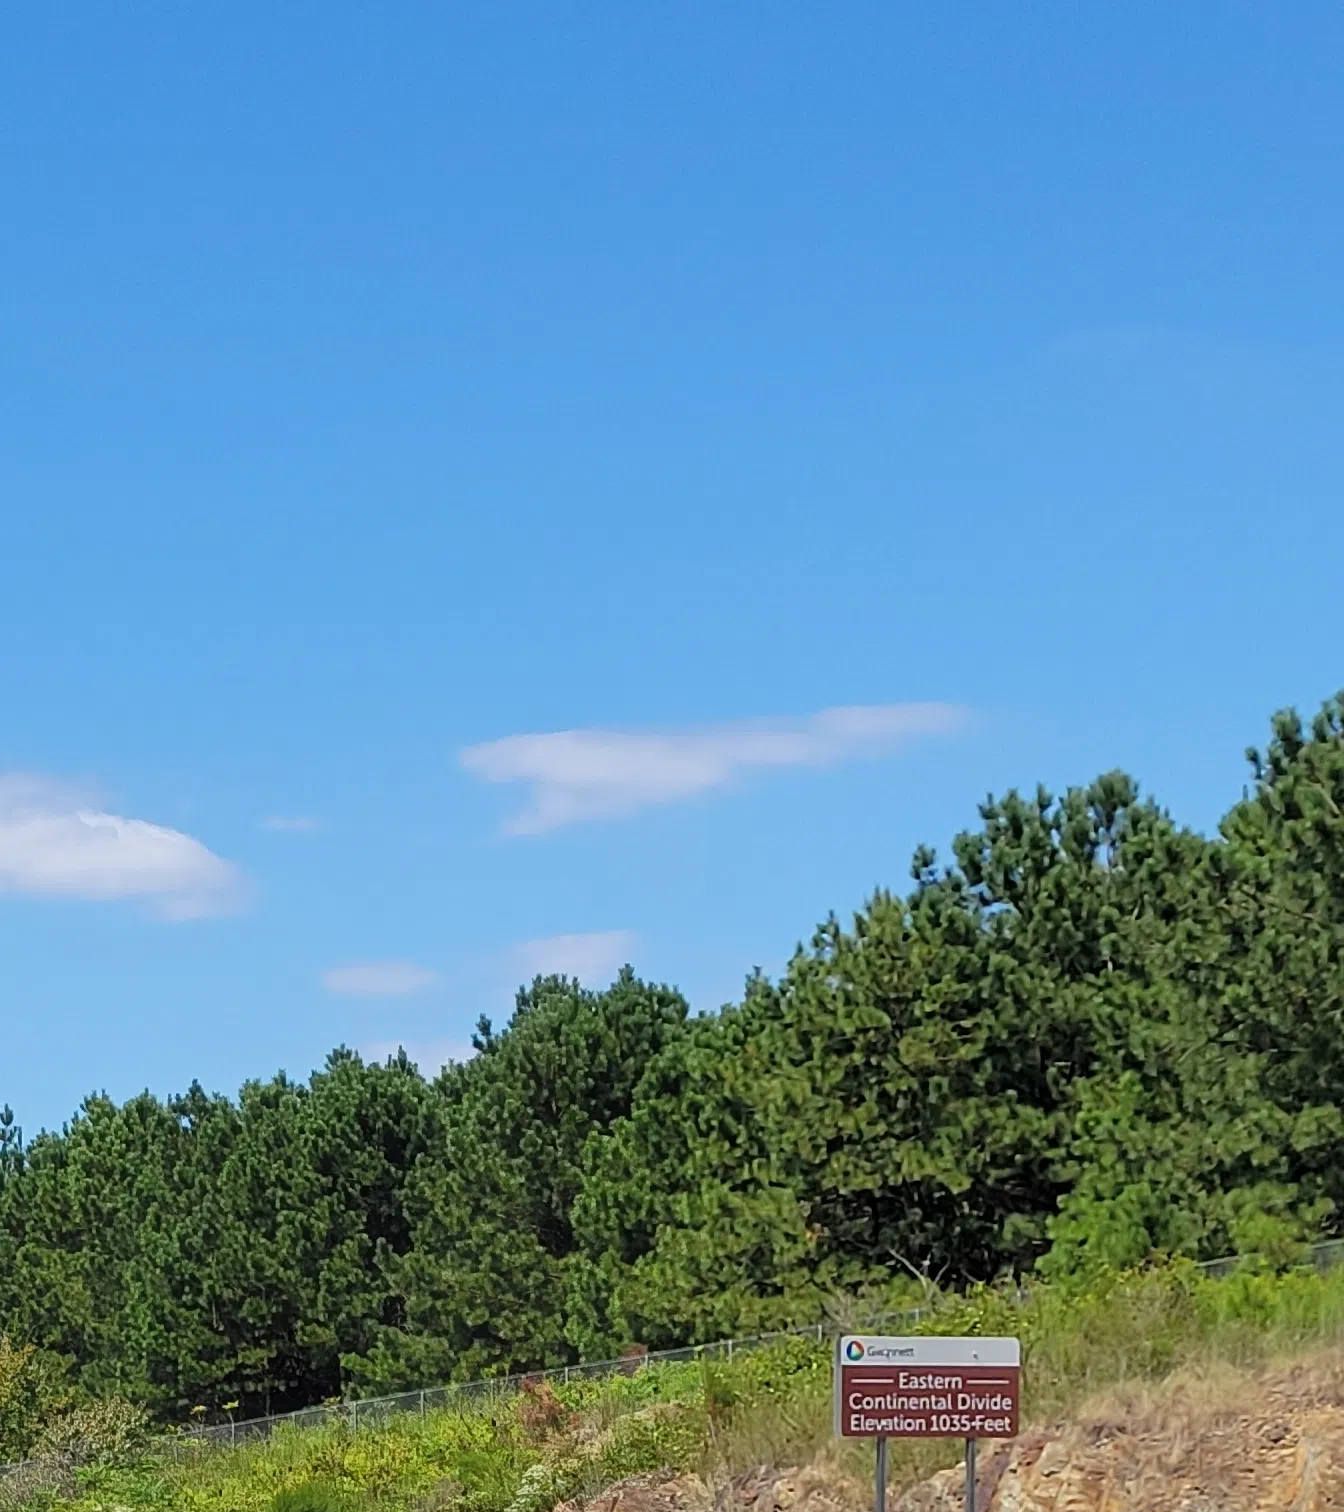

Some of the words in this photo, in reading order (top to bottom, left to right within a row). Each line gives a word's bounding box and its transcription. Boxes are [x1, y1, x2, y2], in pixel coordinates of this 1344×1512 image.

[898, 1372, 962, 1390] Eastern
[849, 1393, 952, 1411] Continental
[957, 1394, 1013, 1411] Divide
[850, 1414, 926, 1432] Elevation
